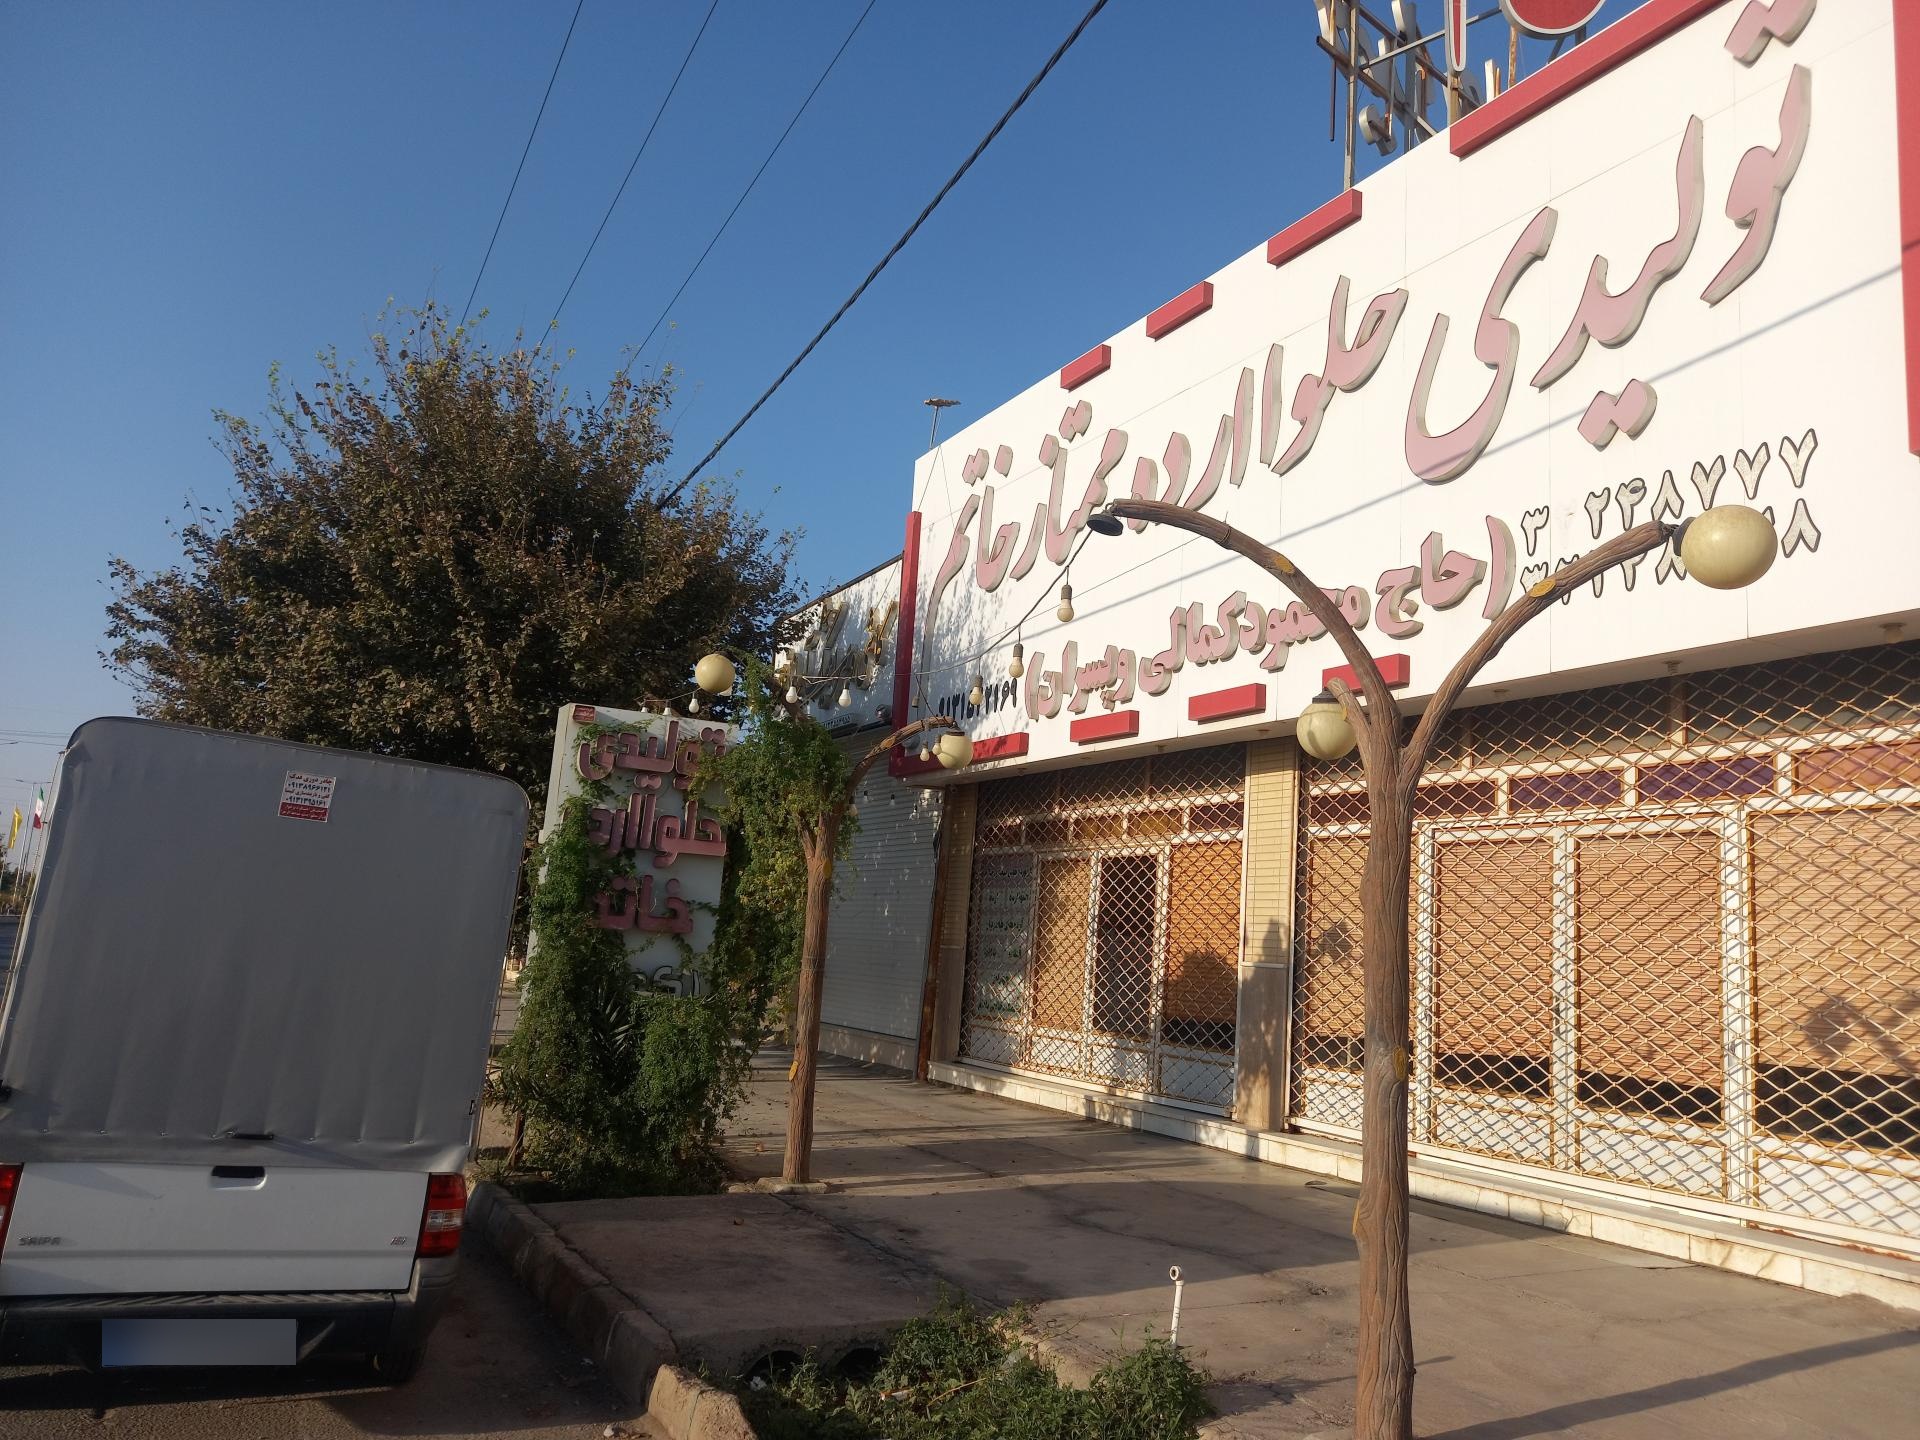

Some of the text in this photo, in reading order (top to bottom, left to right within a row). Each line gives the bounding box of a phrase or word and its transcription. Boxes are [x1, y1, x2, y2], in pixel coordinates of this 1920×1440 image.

[1405, 0, 1816, 486] تولیدی
[1261, 271, 1413, 477] حلوا
[1008, 400, 1129, 582] ممتاز
[1137, 590, 1247, 697] کمالی
